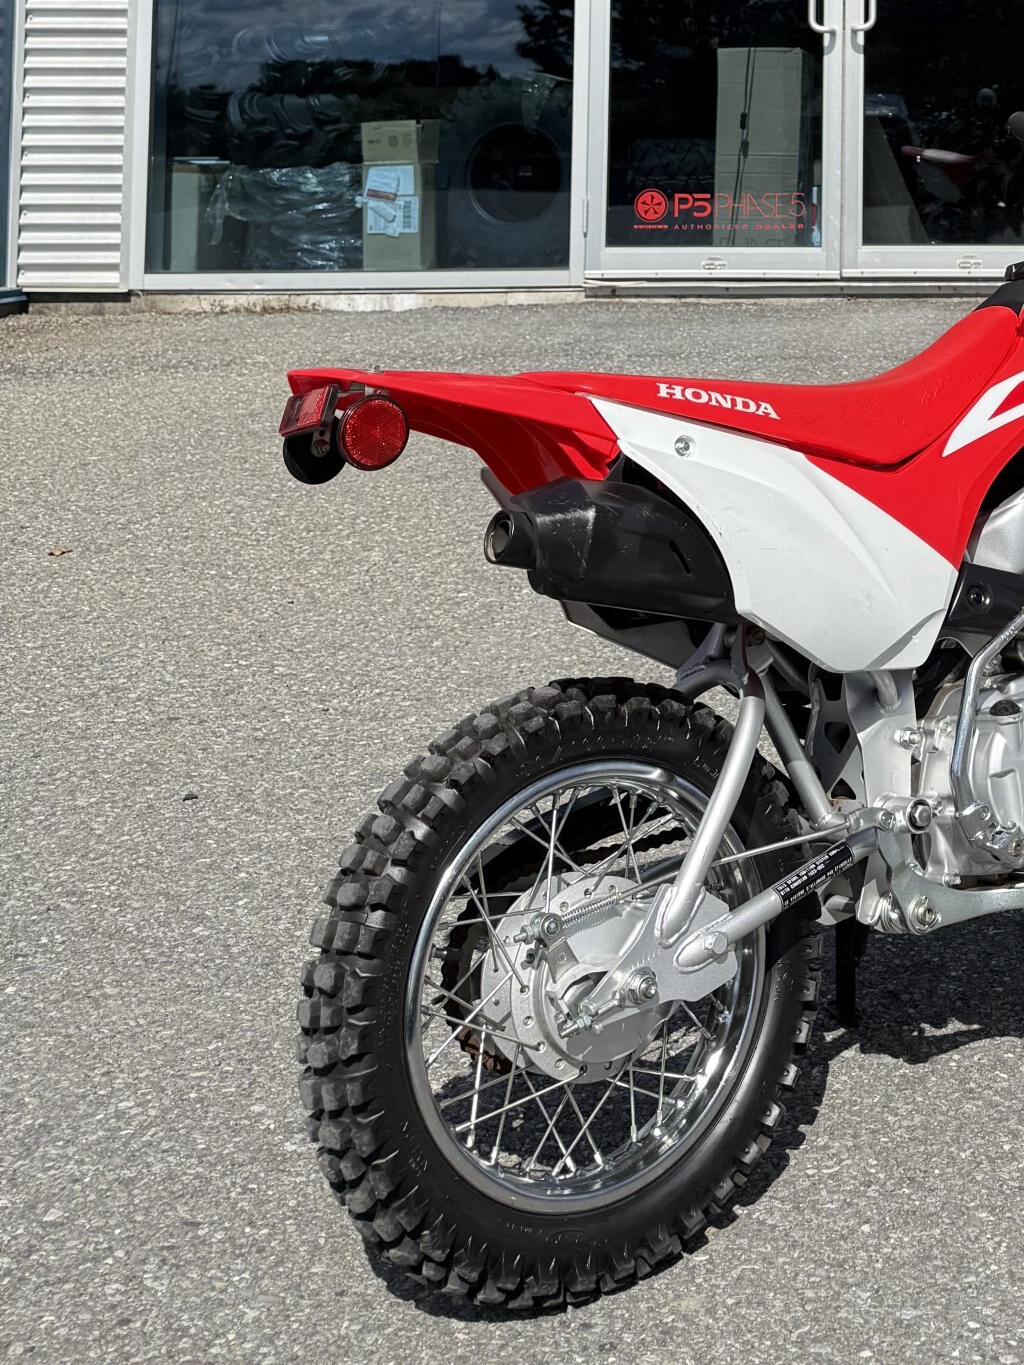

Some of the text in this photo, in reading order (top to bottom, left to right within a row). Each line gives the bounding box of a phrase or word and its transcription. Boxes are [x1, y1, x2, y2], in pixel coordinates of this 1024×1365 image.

[673, 193, 712, 218] P5
[755, 223, 805, 231] DEALER
[655, 381, 781, 421] HONDA
